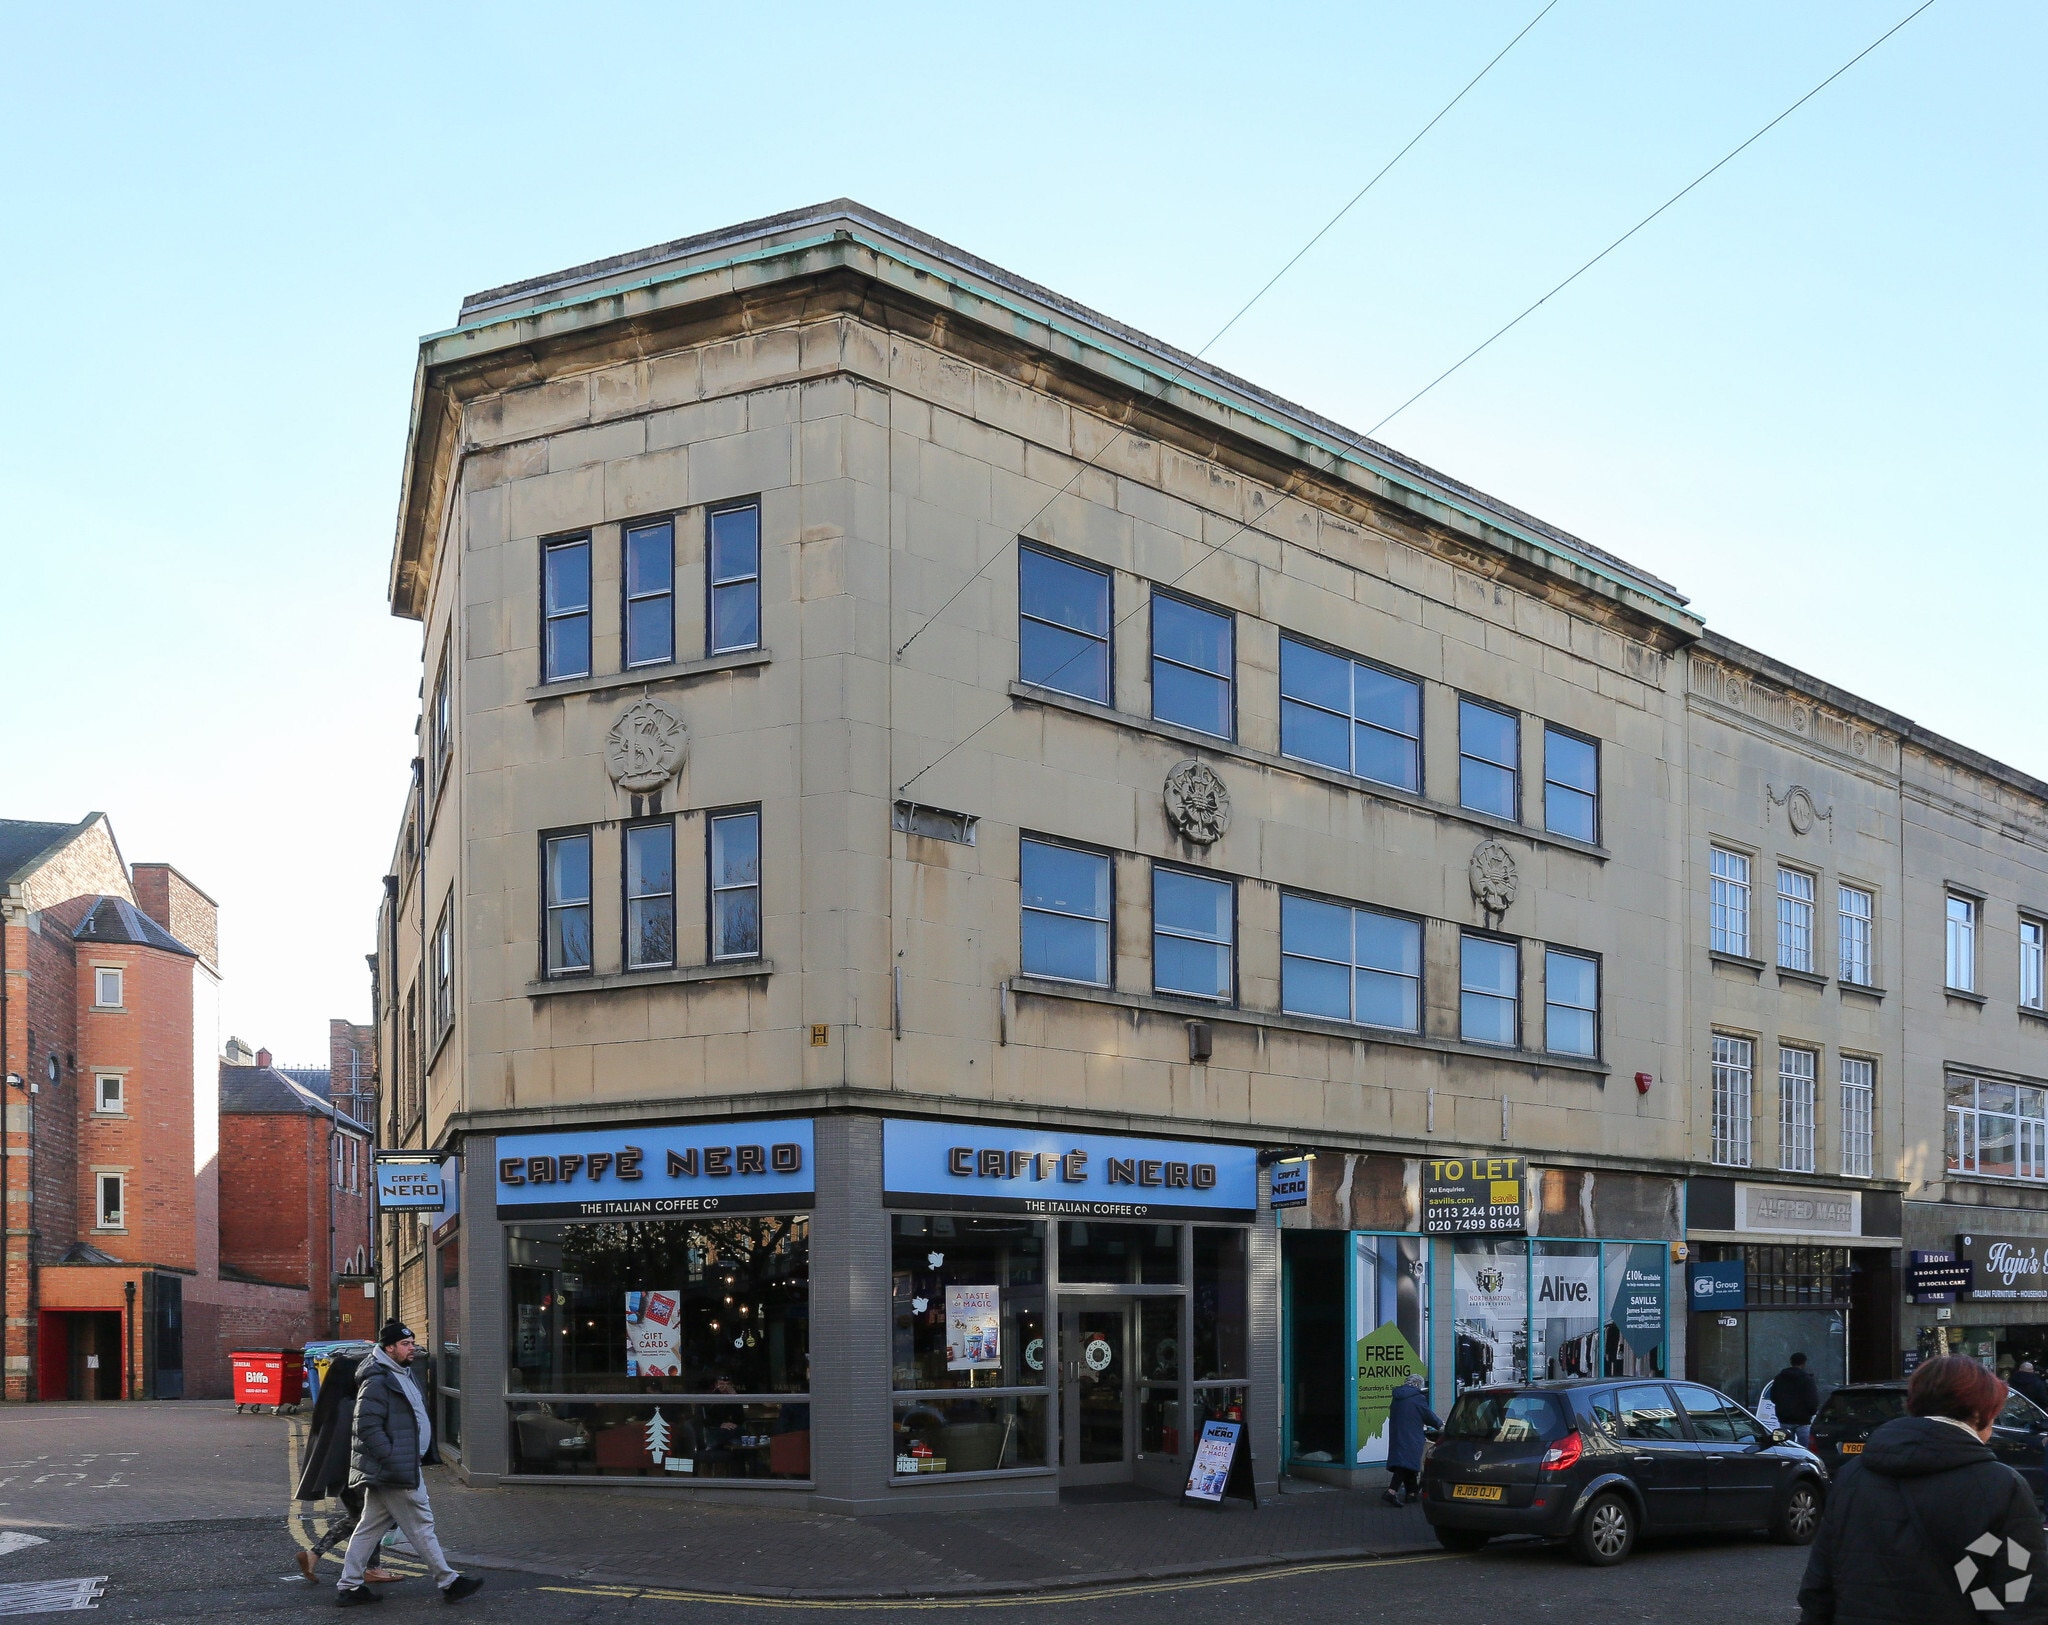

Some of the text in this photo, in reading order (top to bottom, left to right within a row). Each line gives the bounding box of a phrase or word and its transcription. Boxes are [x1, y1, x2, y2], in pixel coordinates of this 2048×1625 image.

[500, 1143, 802, 1184] CAFFÈ NERO
[949, 1147, 1216, 1189] CAFFÈ NERO
[1430, 1159, 1518, 1180] TO LET
[383, 1185, 439, 1196] NERO
[1272, 1181, 1305, 1195] NERO
[1429, 1197, 1474, 1205] savills.com
[1492, 1194, 1517, 1203] savills
[580, 1204, 602, 1214] THE
[605, 1202, 651, 1213] ITALIAN
[655, 1200, 699, 1211] COFFEE
[1025, 1200, 1045, 1211] THE
[1048, 1202, 1090, 1213] ITALIAN
[1094, 1204, 1131, 1215] COFFEE
[1428, 1205, 1520, 1218] 0113 244 0100
[1756, 1198, 1815, 1220] ALFRED
[1428, 1218, 1521, 1231] 020 7499 8644
[1538, 1276, 1591, 1302] Alive.
[1715, 1281, 1738, 1289] Group
[1973, 1290, 1991, 1298] ITALIAN
[2020, 1290, 2047, 1298] HOUSEHOLD
[1366, 1345, 1404, 1361] FREE
[246, 1372, 268, 1383] Biffa
[1358, 1365, 1410, 1378] PARKING
[1207, 1429, 1233, 1438] NERO
